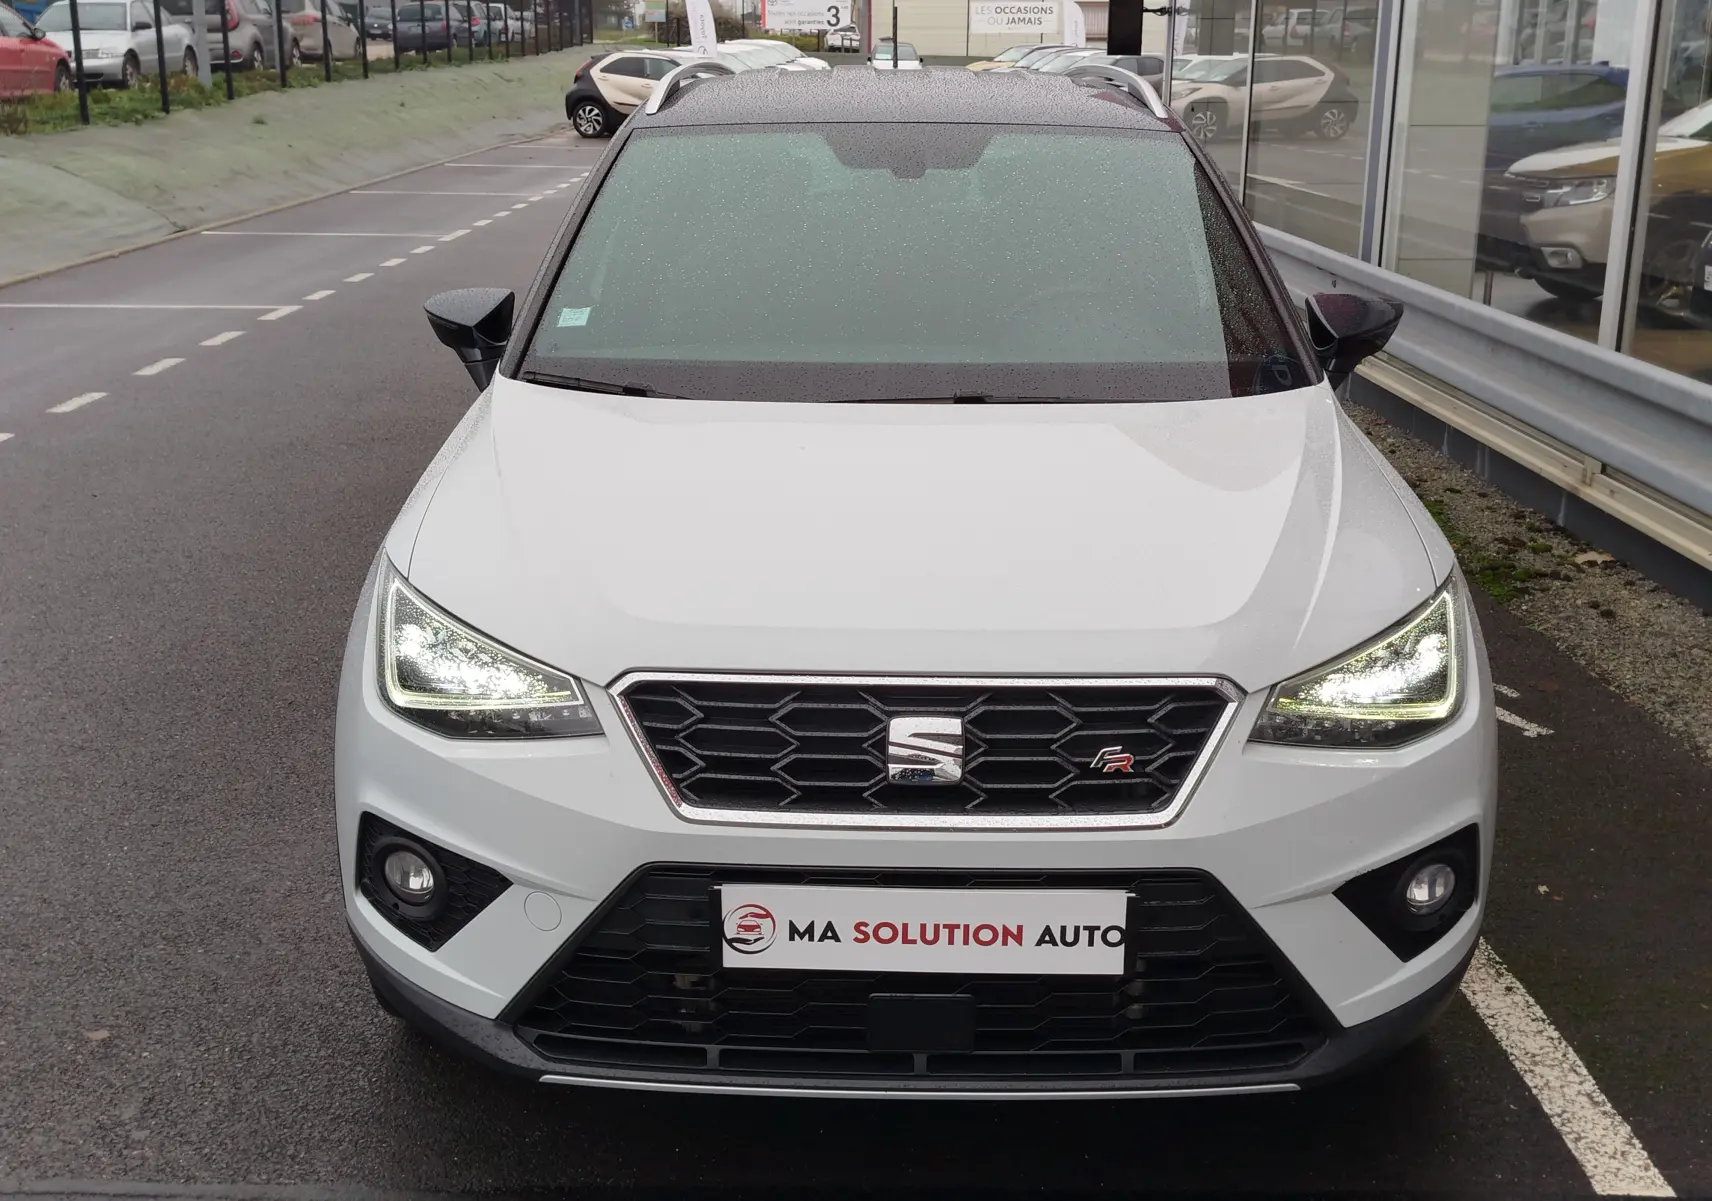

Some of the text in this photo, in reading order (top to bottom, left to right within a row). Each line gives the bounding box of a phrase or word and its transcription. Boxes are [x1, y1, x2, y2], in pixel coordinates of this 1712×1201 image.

[826, 5, 841, 27] 3
[975, 6, 1054, 15] LES OCCASIONS
[988, 17, 1043, 26] OU JAMAIS
[1089, 745, 1135, 773] FR
[788, 919, 1126, 948] MA SOLUTION AUTO
